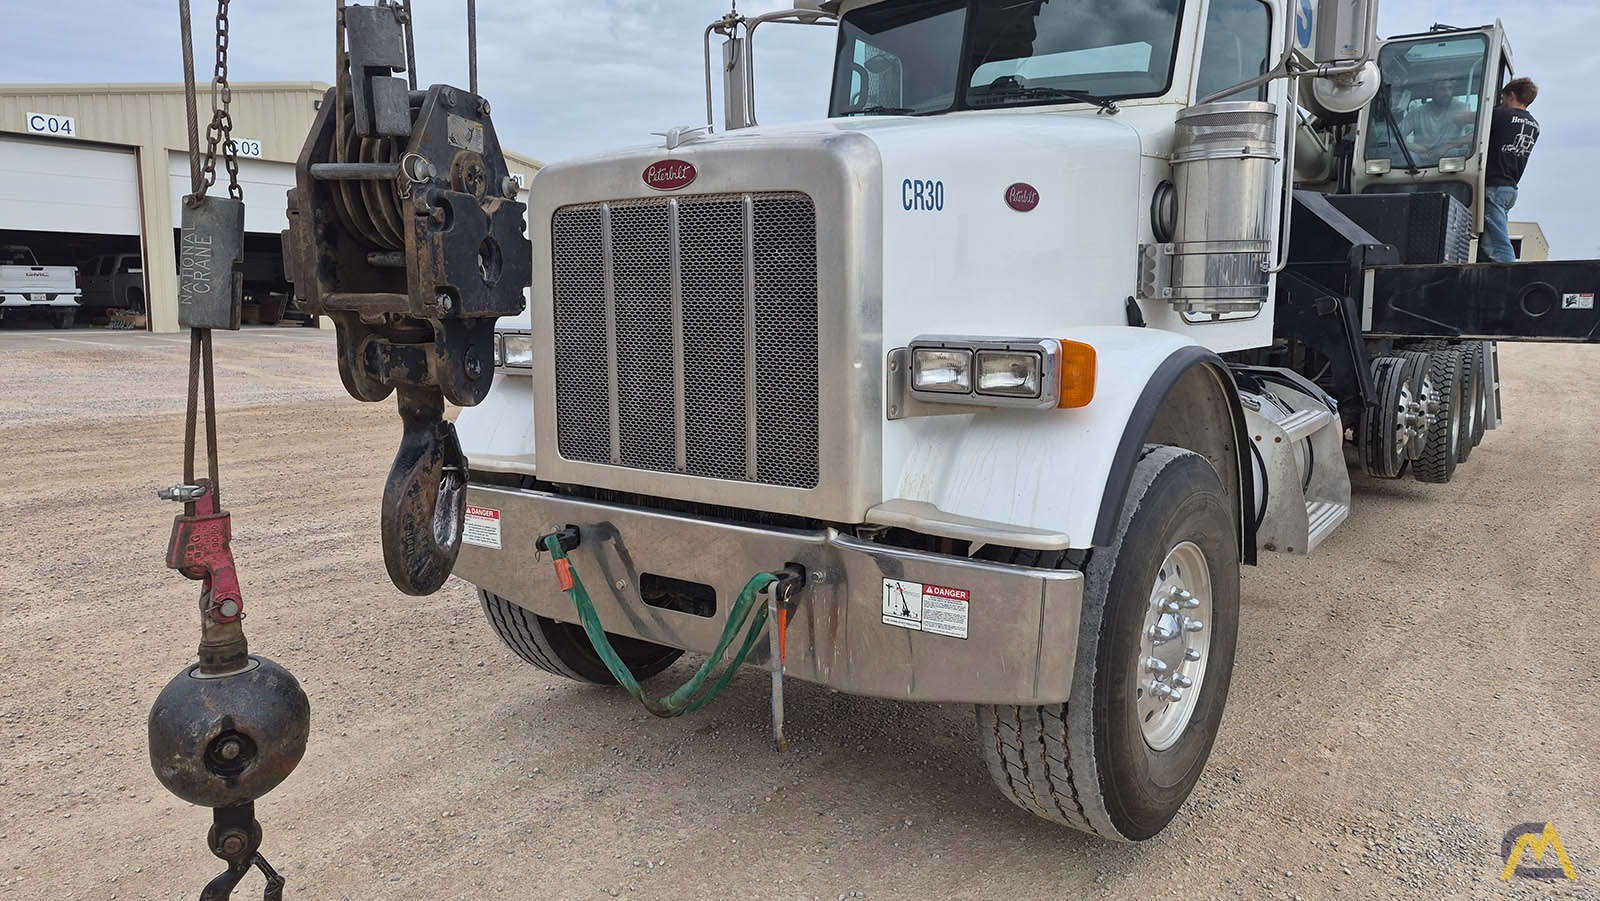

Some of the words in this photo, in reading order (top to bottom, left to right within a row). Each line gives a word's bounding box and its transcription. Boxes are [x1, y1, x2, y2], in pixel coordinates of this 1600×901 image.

[30, 115, 72, 135] C04
[647, 165, 691, 184] Peterbilt
[902, 178, 944, 212] CR30
[1009, 186, 1037, 204] Peterbilt
[181, 222, 196, 305] NATIONAL
[192, 234, 212, 294] CRANE
[471, 508, 494, 518] DANGER
[934, 587, 966, 599] DANGER
